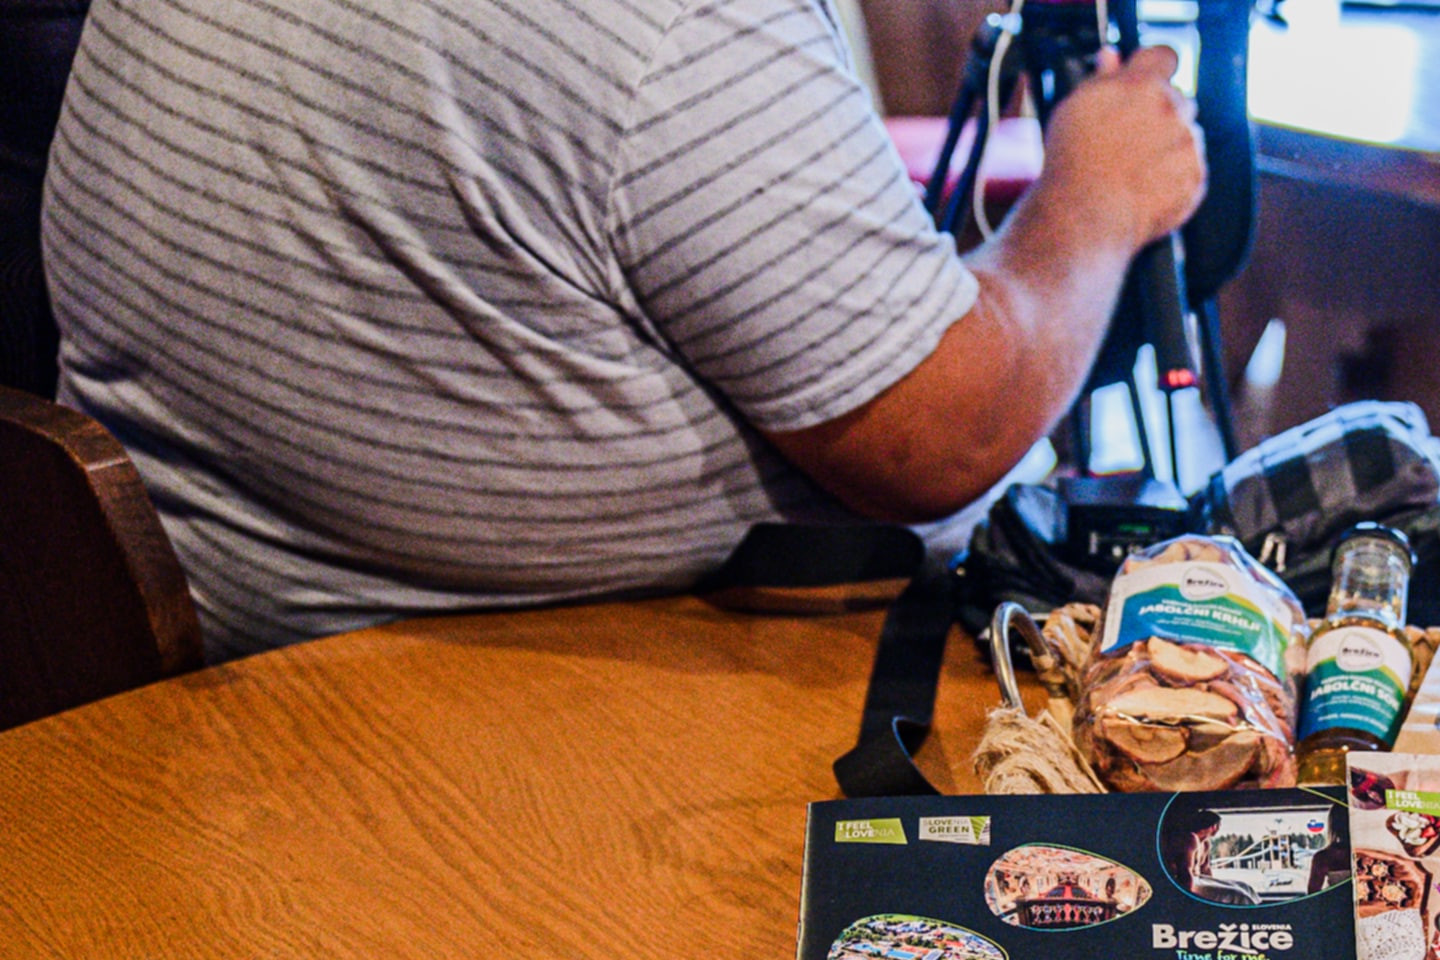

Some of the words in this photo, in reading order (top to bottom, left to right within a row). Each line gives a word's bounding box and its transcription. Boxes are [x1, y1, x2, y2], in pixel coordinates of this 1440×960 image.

[846, 821, 873, 831] FEEL
[928, 825, 970, 834] GREEN
[1252, 923, 1293, 931] SLOVENIA
[1151, 923, 1294, 955] Brežice
